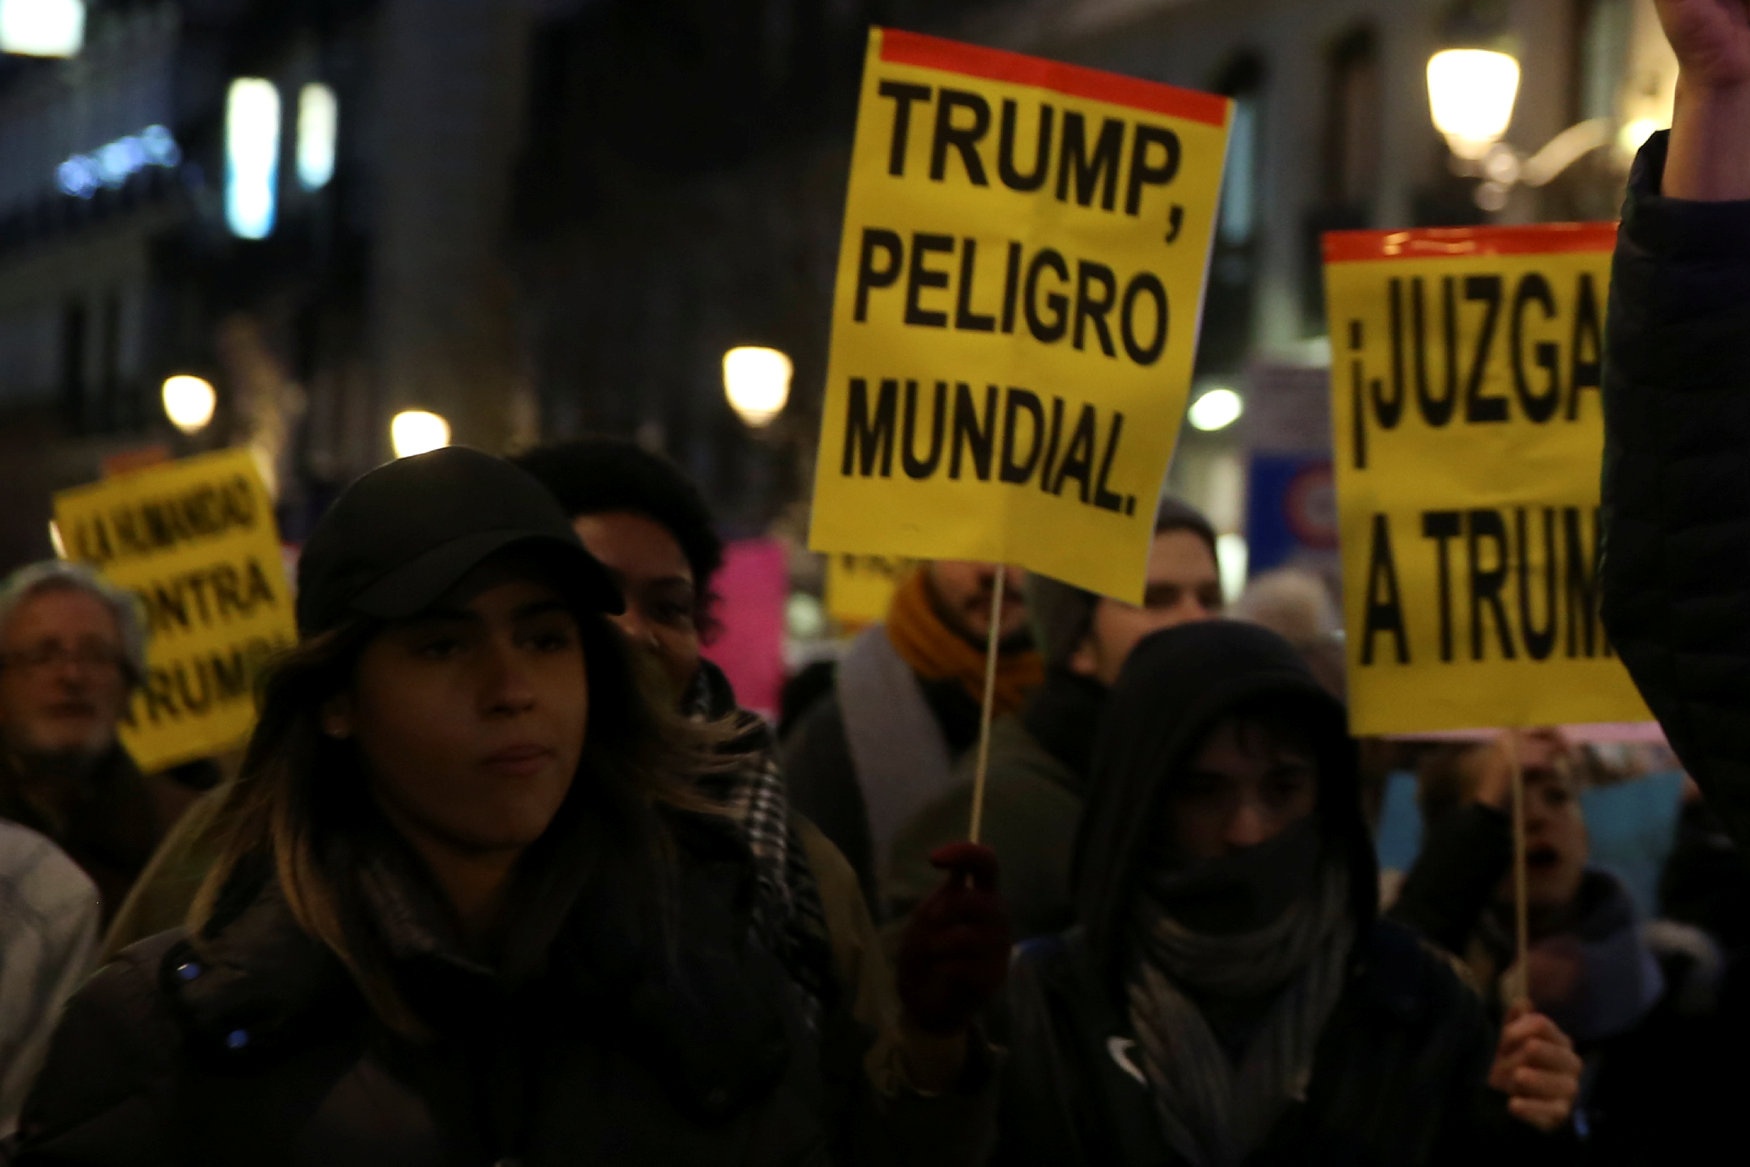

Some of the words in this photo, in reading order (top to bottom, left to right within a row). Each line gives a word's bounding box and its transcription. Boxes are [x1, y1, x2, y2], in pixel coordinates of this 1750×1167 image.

[878, 78, 1185, 244] TRUMP,
[853, 227, 1169, 366] PELIGRO
[841, 377, 1136, 517] MUNDIAL.
[1360, 513, 1410, 665] A
[1421, 506, 1616, 664] TRUM
